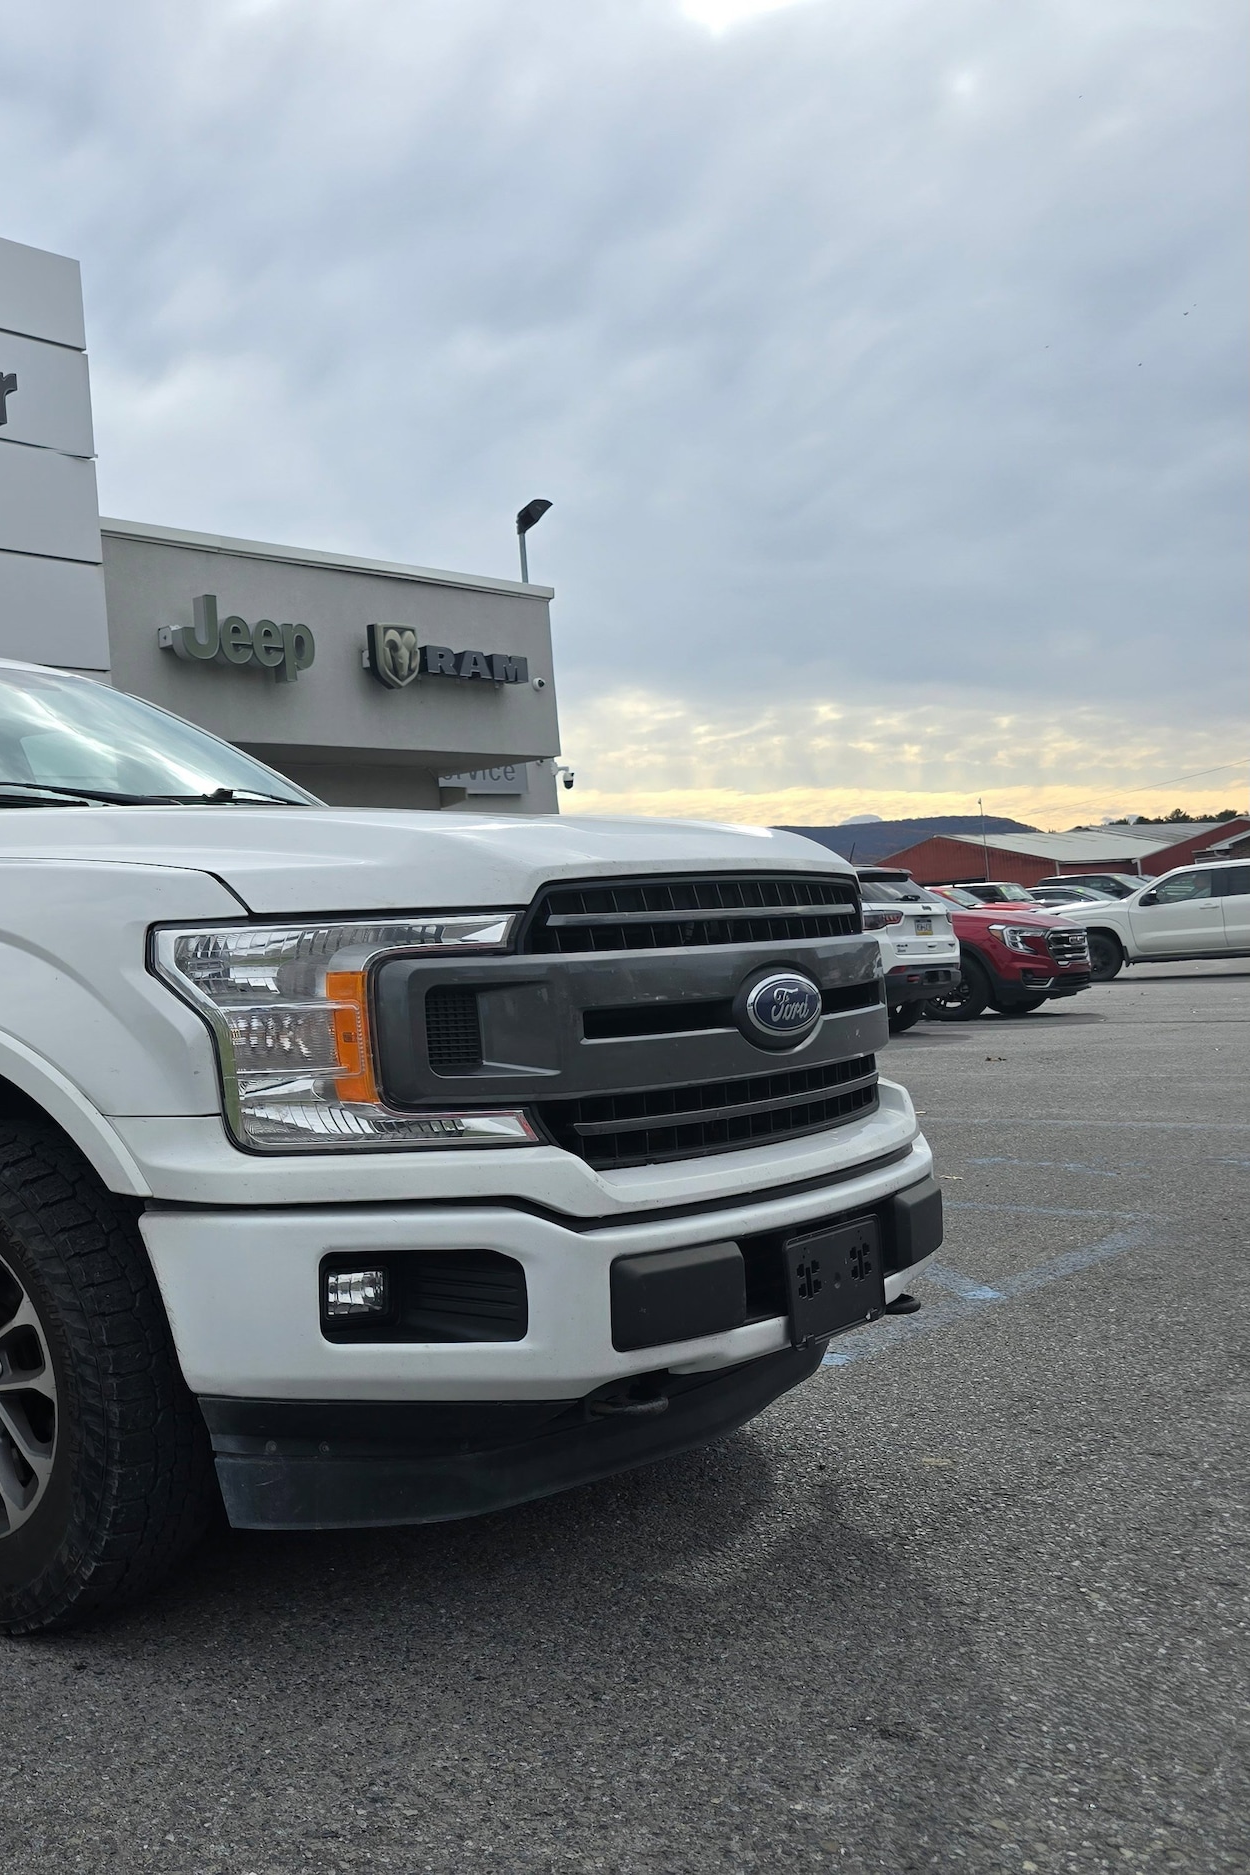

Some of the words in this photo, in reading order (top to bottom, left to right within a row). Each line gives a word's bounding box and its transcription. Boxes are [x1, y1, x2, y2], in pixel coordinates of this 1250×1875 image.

[173, 594, 316, 683] Jeep
[422, 645, 529, 685] RAM
[771, 987, 810, 1022] Ford
